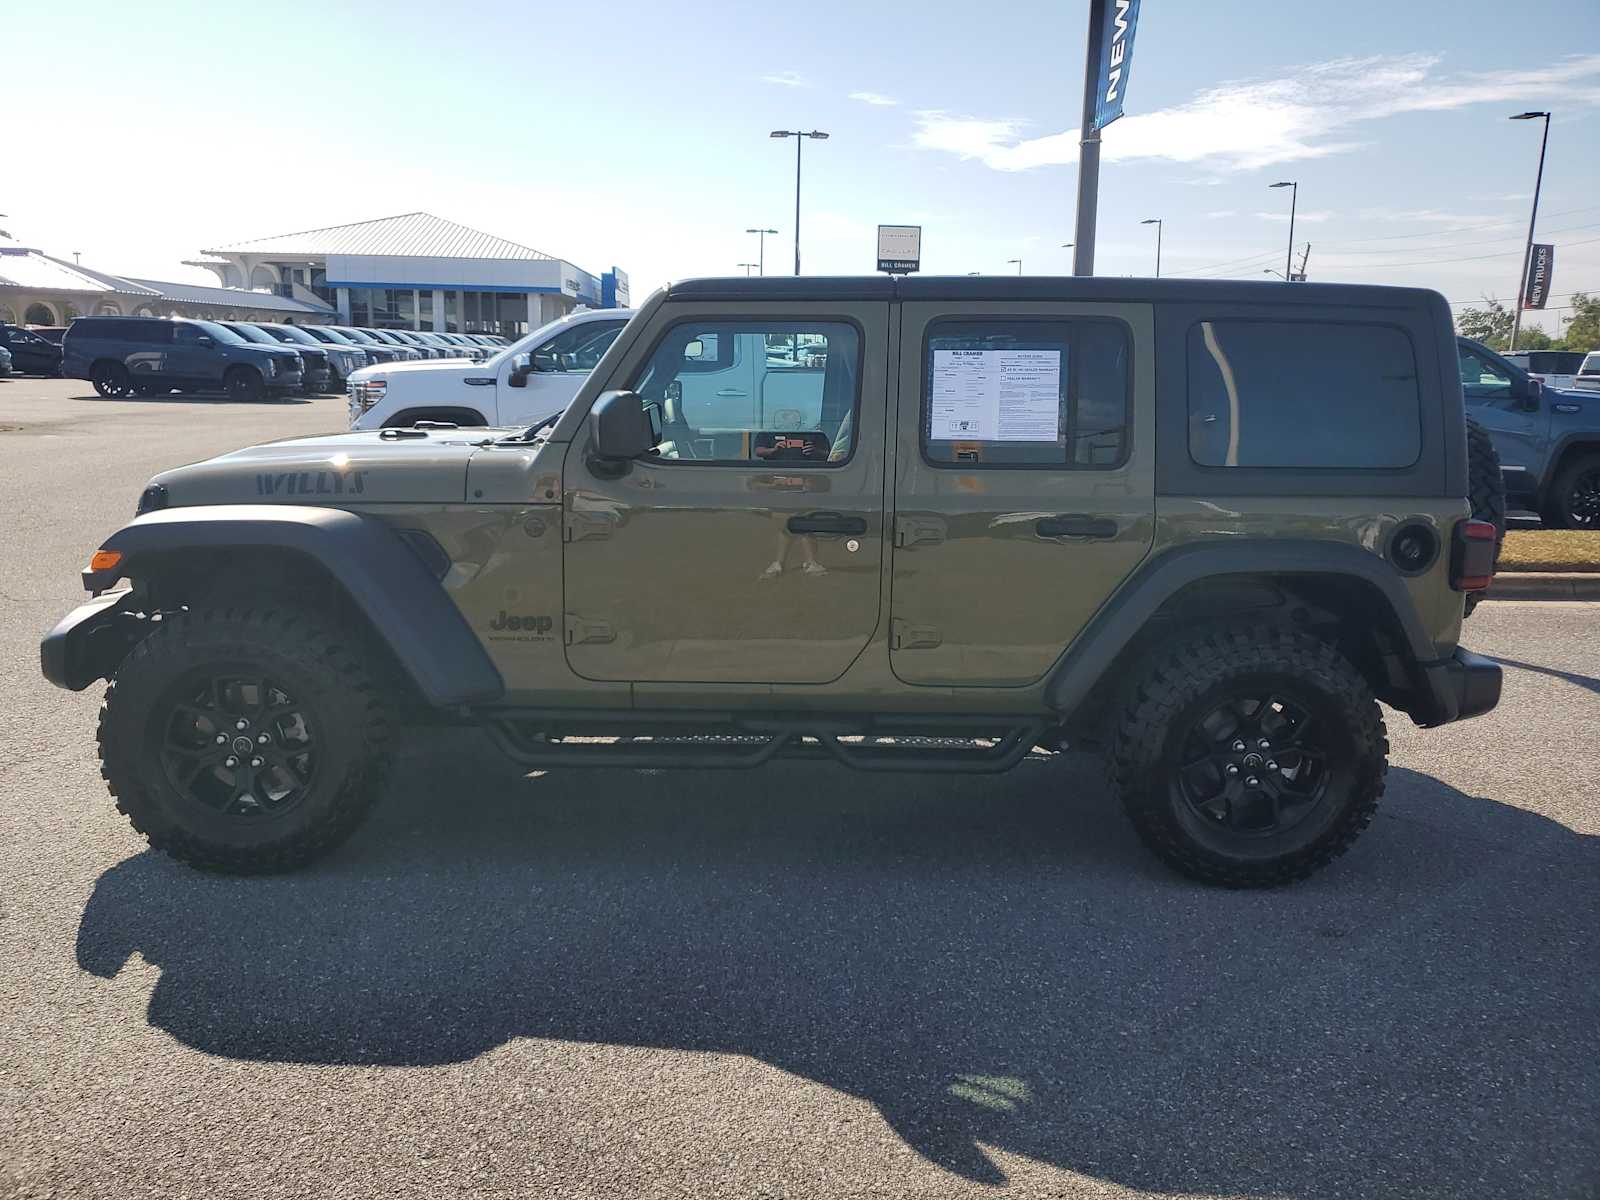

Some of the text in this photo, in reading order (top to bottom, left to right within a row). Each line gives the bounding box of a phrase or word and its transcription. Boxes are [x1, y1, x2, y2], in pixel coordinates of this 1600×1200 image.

[1105, 0, 1130, 102] NEW
[1531, 248, 1546, 305] NEW TRUCKS
[489, 610, 552, 635] Jeep
